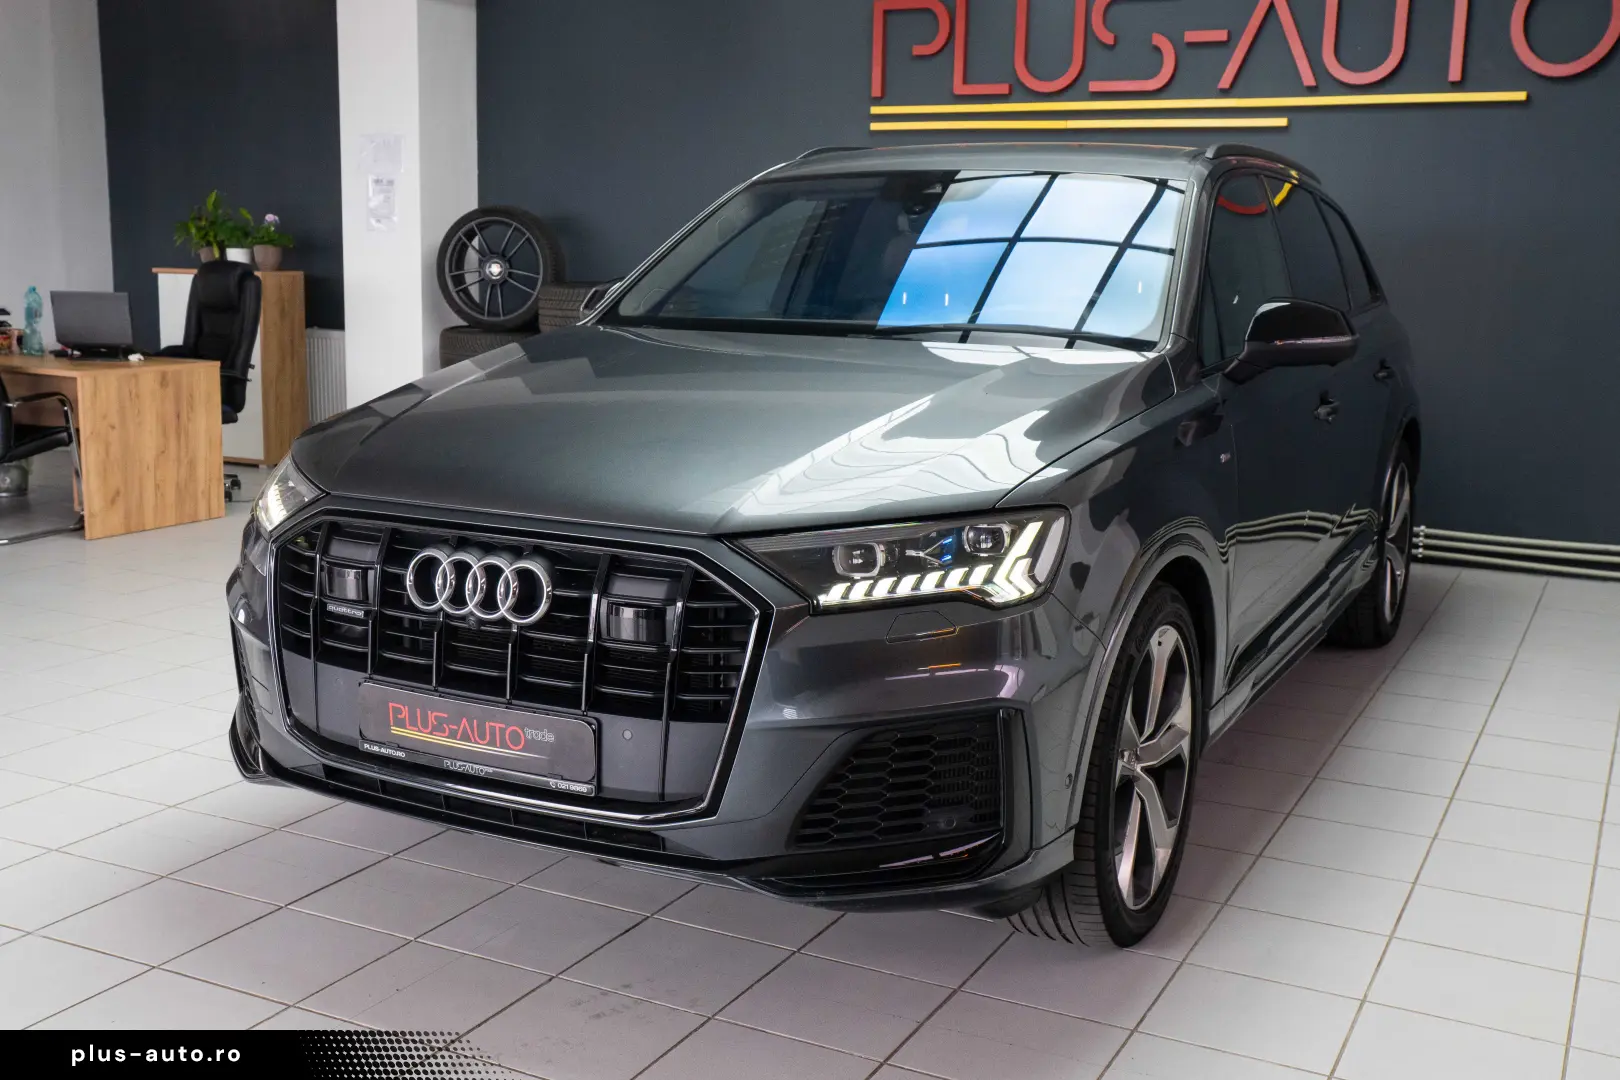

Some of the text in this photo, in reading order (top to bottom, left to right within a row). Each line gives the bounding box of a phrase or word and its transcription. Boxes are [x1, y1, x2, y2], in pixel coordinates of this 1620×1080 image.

[328, 605, 362, 616] quattro
[388, 702, 554, 750] PLUS-AUTO trade
[443, 759, 485, 776] PLUS-AUTO
